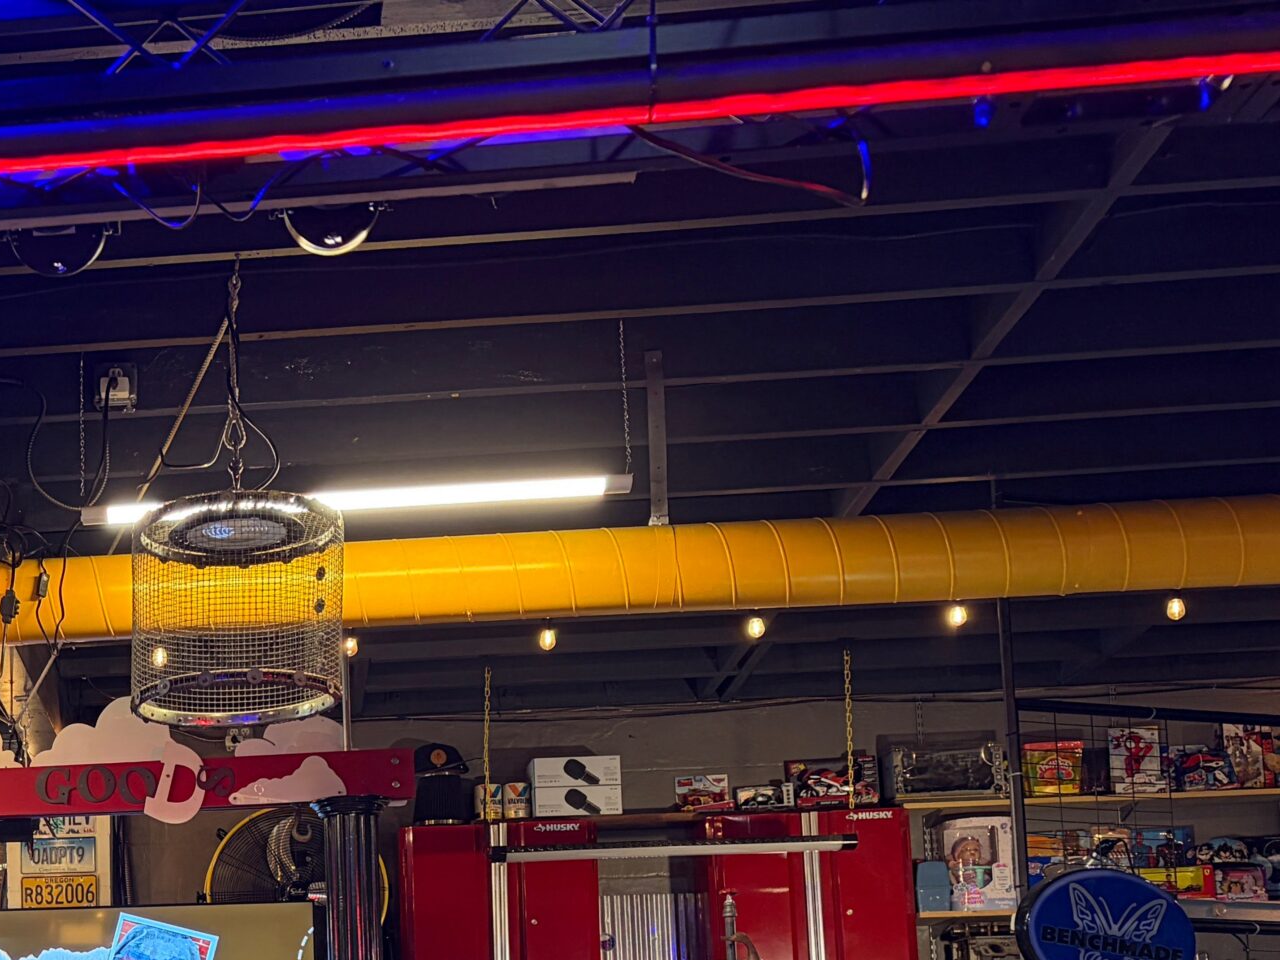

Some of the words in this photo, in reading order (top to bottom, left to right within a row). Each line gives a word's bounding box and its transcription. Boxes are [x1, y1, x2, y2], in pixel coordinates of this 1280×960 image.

[36, 741, 235, 824] GOODS
[858, 811, 893, 820] HUSKY
[546, 823, 580, 831] HUSKY
[24, 883, 95, 905] R832006
